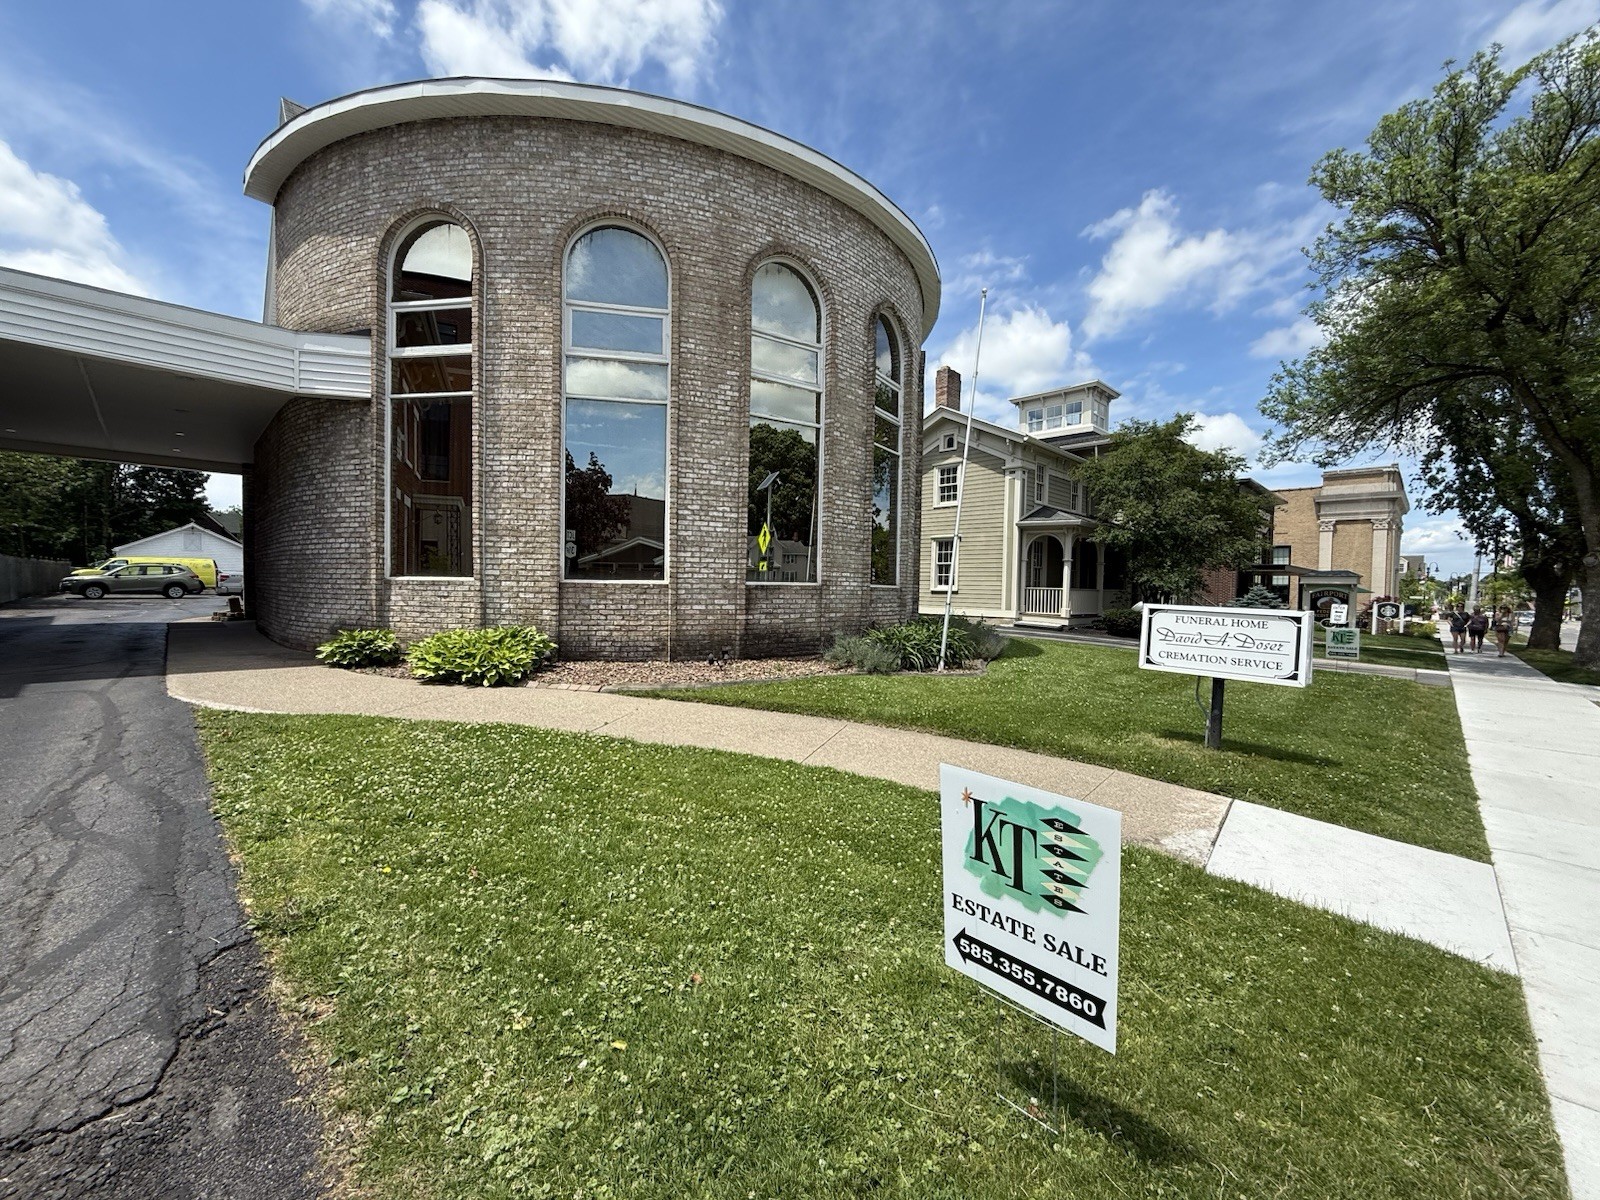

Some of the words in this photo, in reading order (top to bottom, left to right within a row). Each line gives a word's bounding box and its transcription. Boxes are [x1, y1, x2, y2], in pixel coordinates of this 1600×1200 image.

[1312, 591, 1347, 600] FAIRPORT
[1156, 627, 1203, 644] David
[1204, 632, 1230, 647] A.
[1233, 632, 1284, 652] Doser
[1175, 615, 1228, 627] FUNERAL
[1231, 619, 1269, 630] HOME
[1158, 650, 1227, 664] CREMATION
[1230, 657, 1283, 671] SERVICE
[968, 796, 1037, 896] KT
[1053, 820, 1064, 907] ESTATES
[951, 892, 1036, 945] ESTATE
[1043, 933, 1108, 977] SALE
[959, 938, 1097, 1018] 585.355.7860
